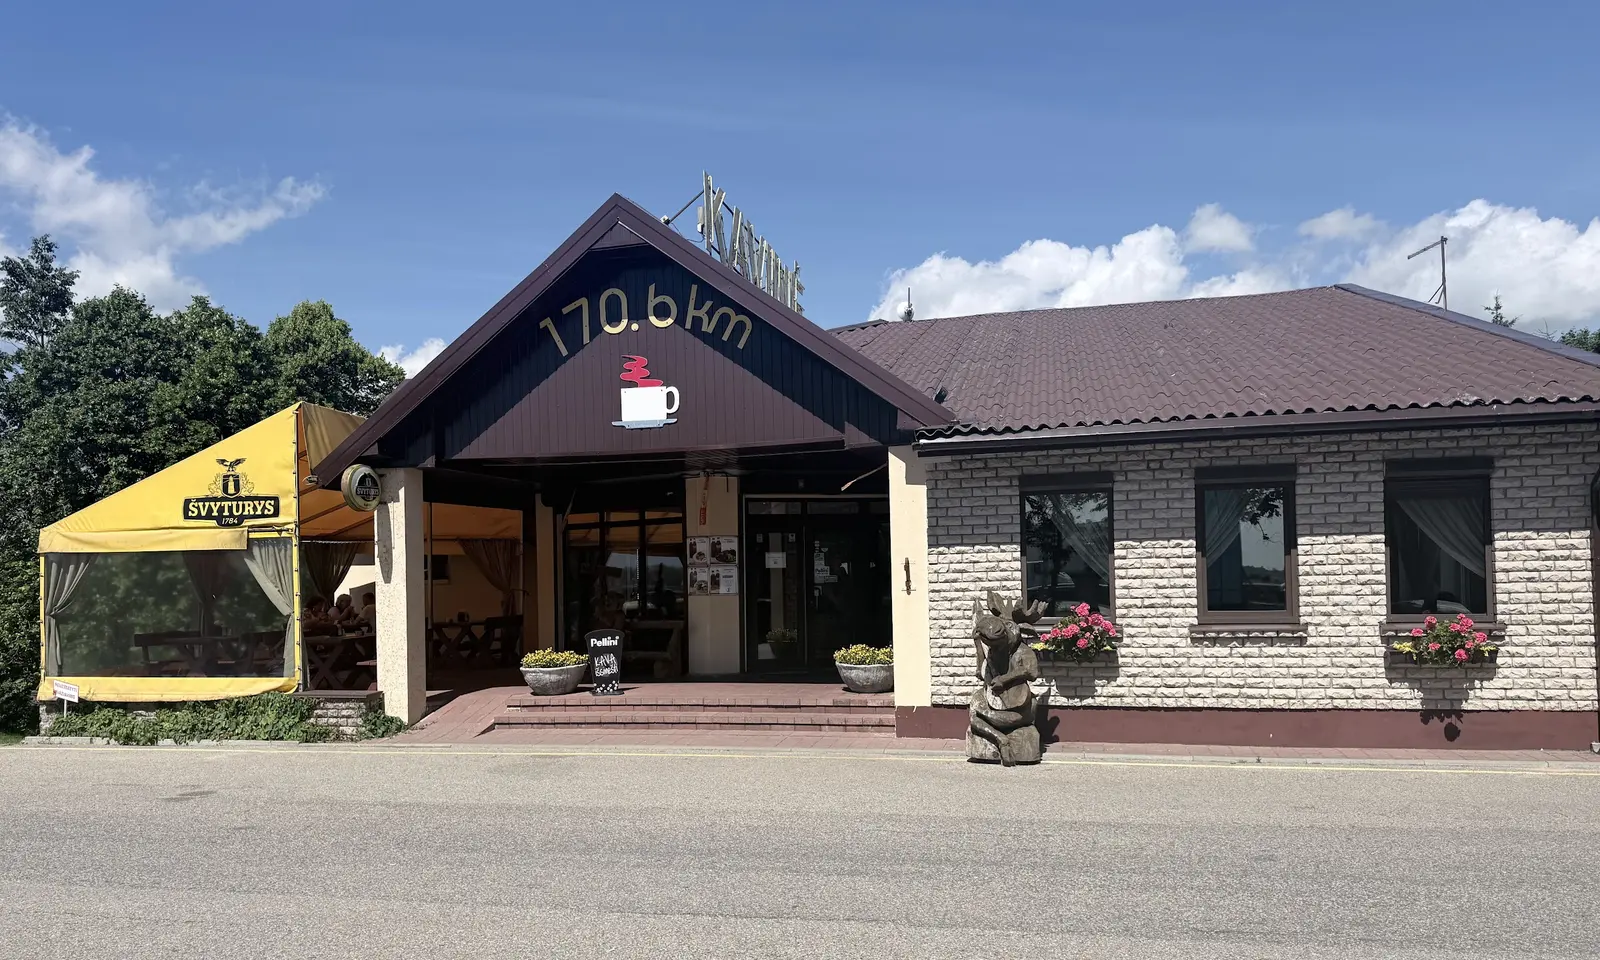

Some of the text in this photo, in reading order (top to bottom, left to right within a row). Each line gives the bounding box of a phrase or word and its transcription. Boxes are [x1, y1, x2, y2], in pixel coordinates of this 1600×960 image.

[539, 283, 753, 357] 170.6 km
[188, 499, 275, 517] ŠVYTURYS
[222, 517, 238, 525] 1784
[591, 636, 619, 647] Pellini
[594, 653, 617, 666] KAVA
